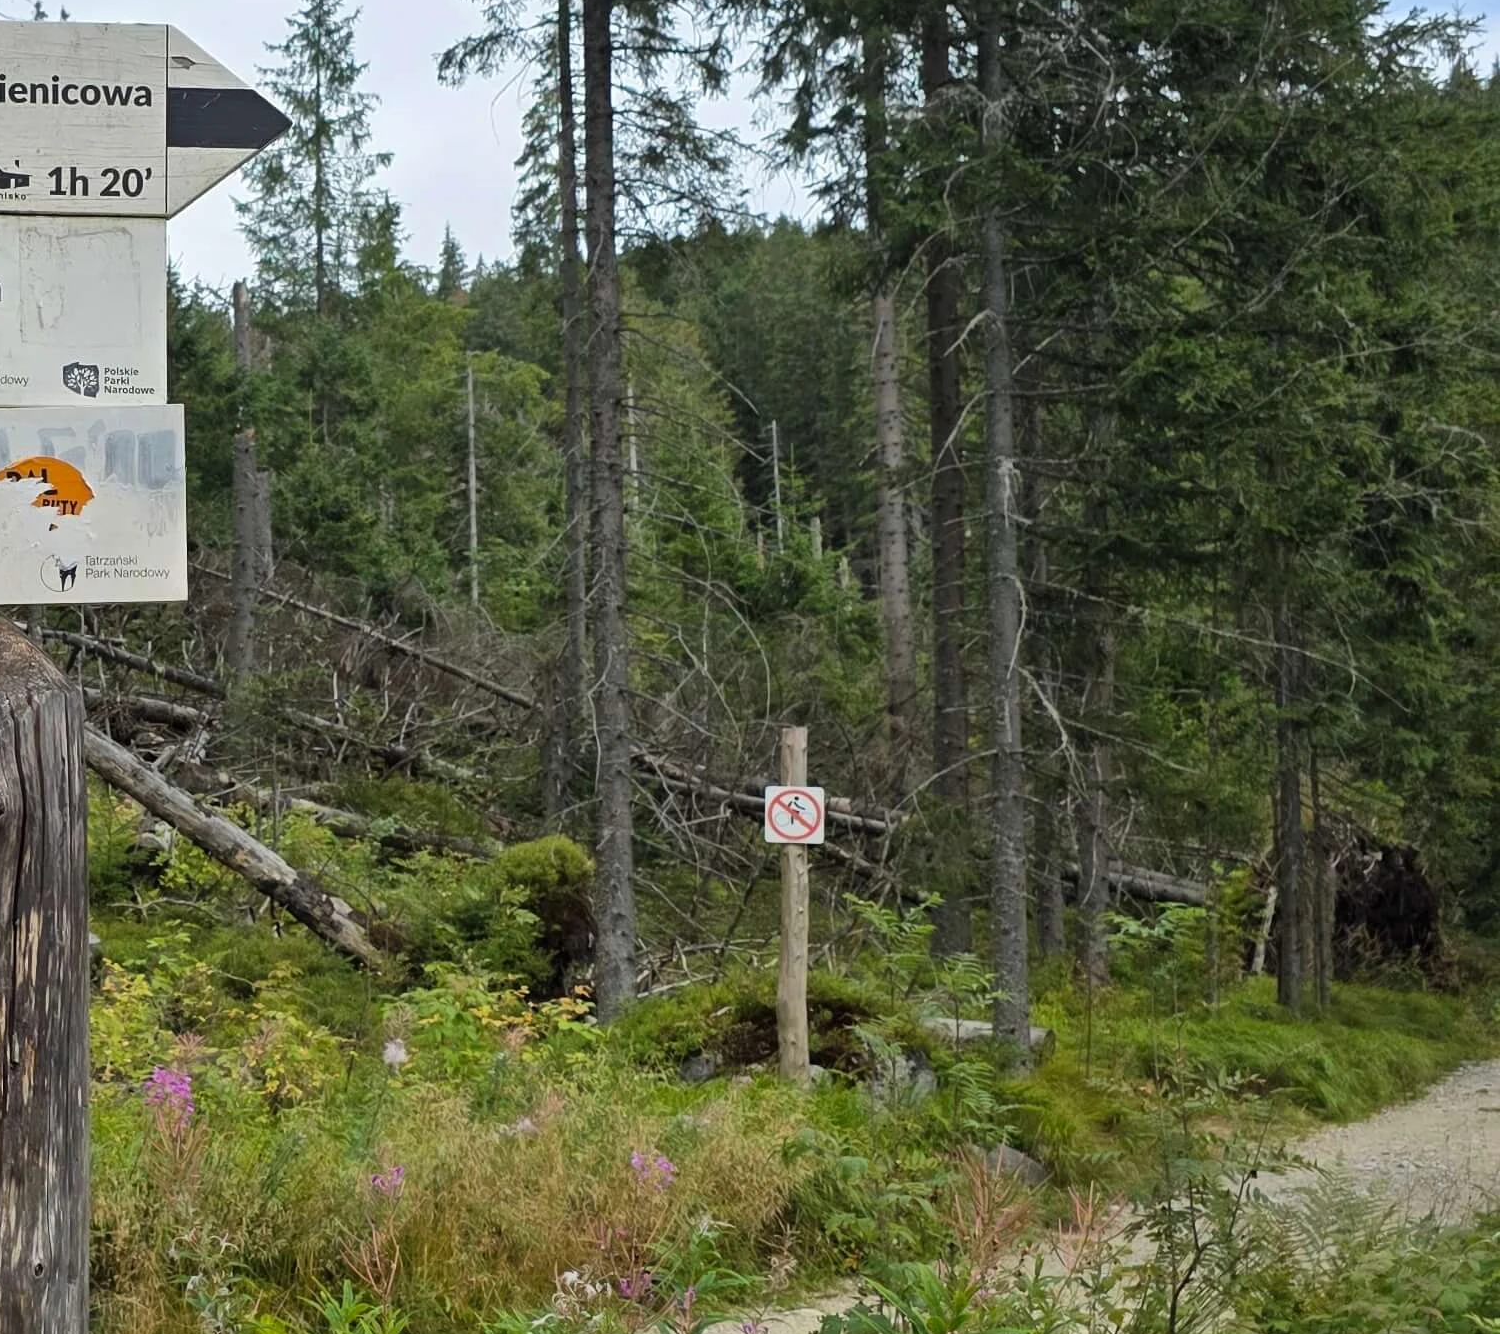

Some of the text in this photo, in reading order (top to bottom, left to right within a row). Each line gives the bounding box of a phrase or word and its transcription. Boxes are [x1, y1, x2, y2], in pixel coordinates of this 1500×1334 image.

[48, 167, 90, 197] 1h
[104, 367, 139, 376] Polskie
[104, 376, 129, 385] Parki
[104, 385, 156, 395] Narodowe
[85, 555, 138, 566] Tatrzański
[85, 568, 170, 579] Park Narodowy
